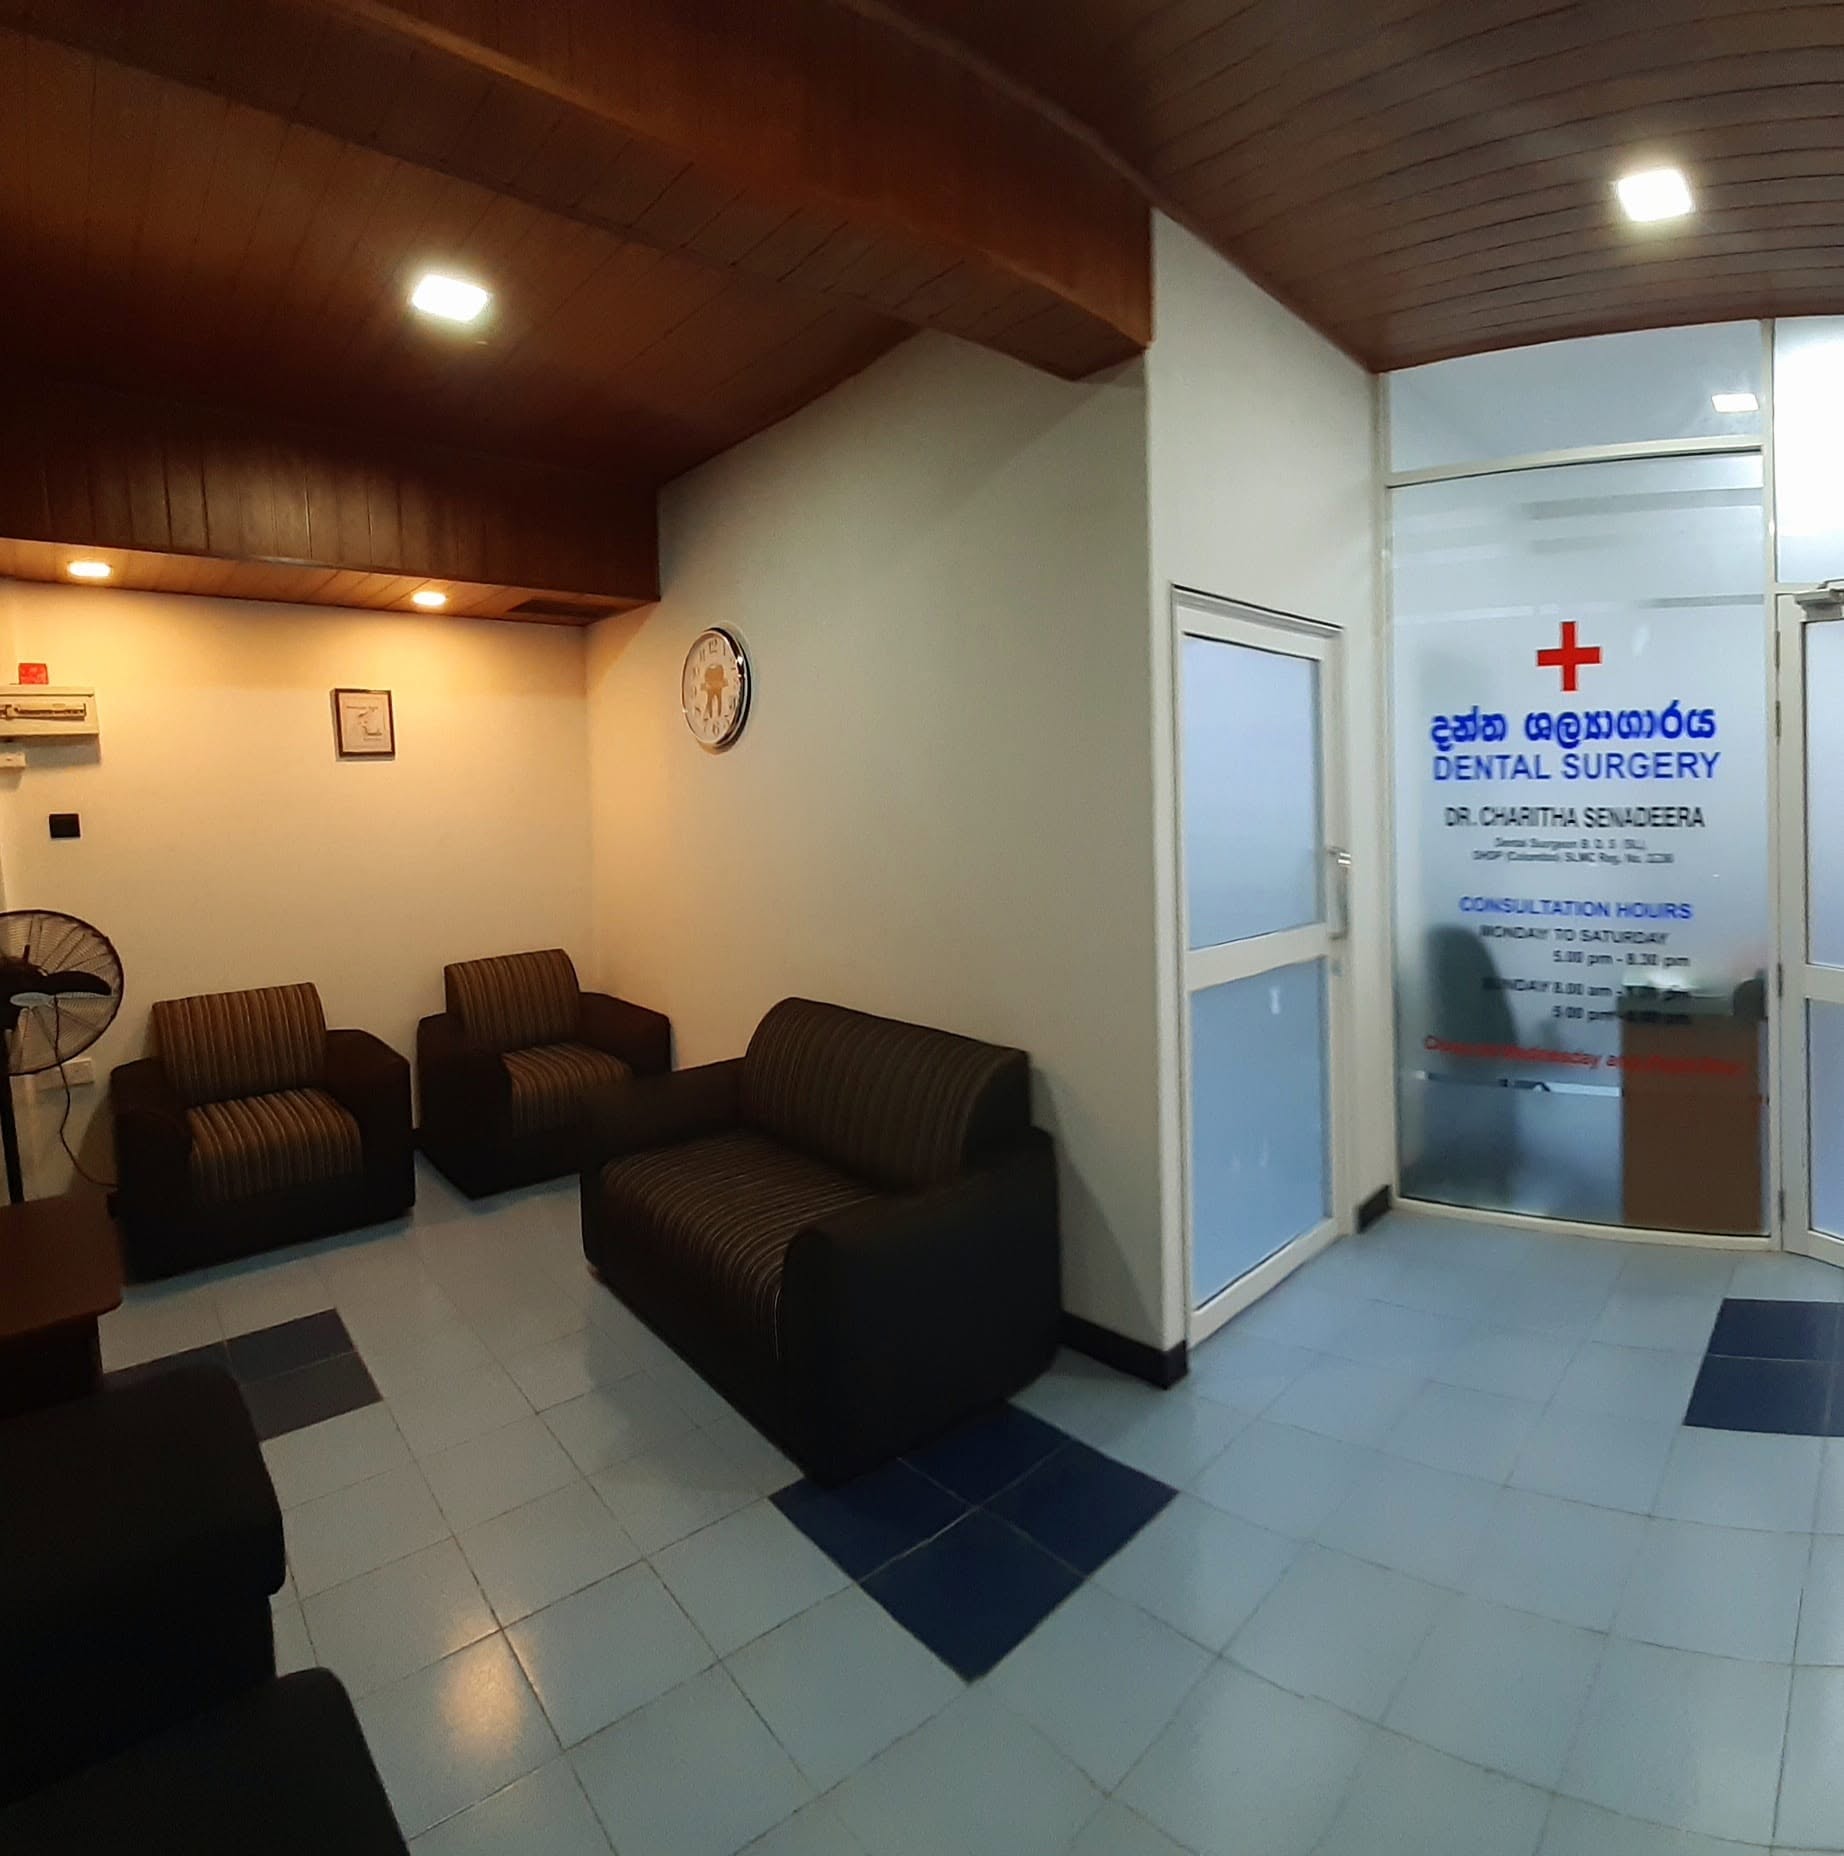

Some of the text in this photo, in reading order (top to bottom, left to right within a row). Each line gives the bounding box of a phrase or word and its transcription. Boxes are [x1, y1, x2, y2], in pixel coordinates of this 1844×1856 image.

[1433, 752, 1721, 781] DENTAL SURGERY
[1479, 807, 1579, 828] CHARITHA
[1583, 807, 1705, 829] SENADEERA
[1459, 897, 1693, 920] CONSULTATION HOURS
[1480, 925, 1671, 944] MONDAY TO SATURDAY
[1587, 954, 1614, 967] pm
[1662, 956, 1691, 969] pm
[1587, 986, 1614, 997] am
